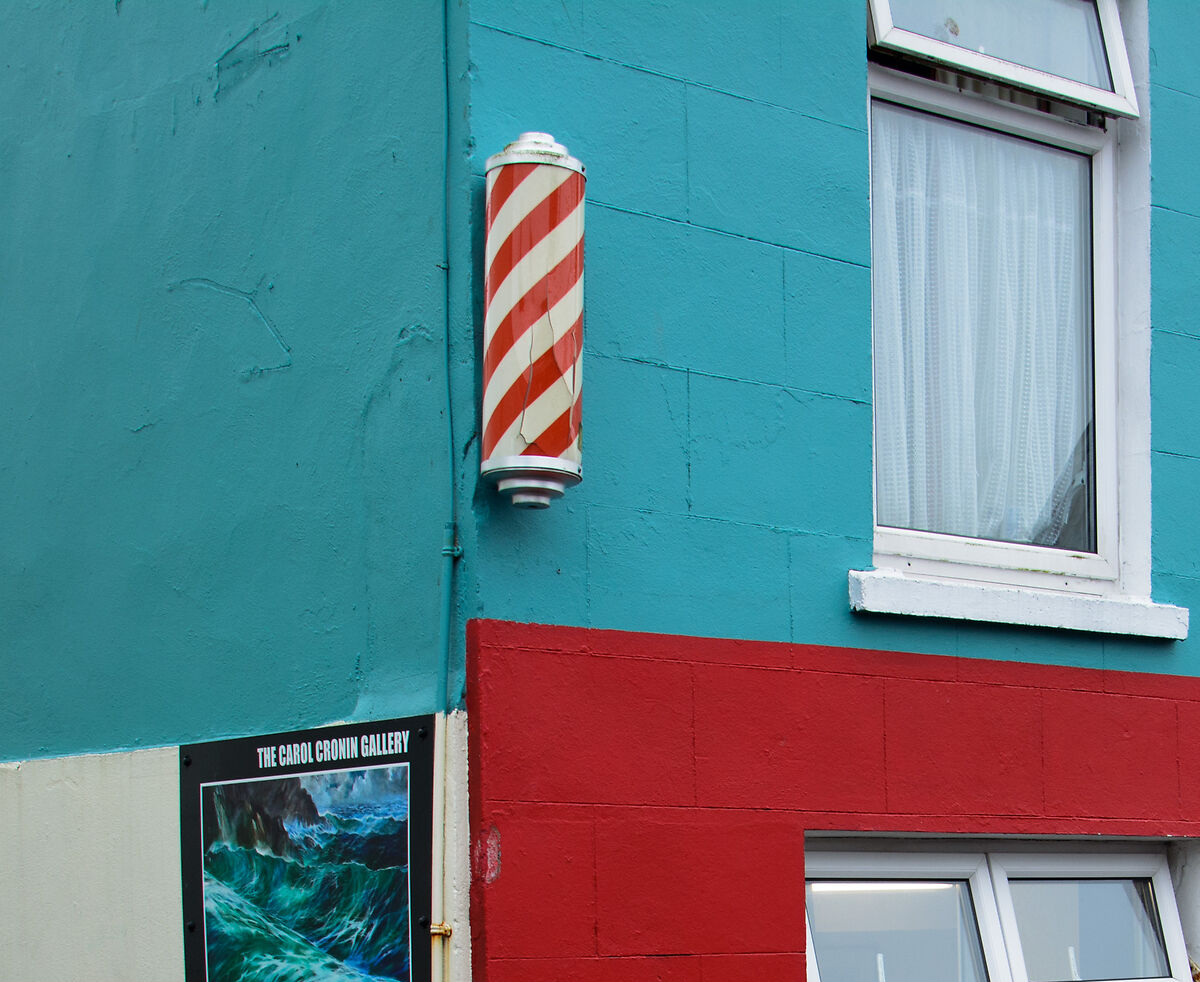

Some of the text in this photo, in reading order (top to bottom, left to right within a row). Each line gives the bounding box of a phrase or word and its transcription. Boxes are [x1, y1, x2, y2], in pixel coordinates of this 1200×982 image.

[257, 730, 410, 769] THE CAROL CRONIN GALLERY
